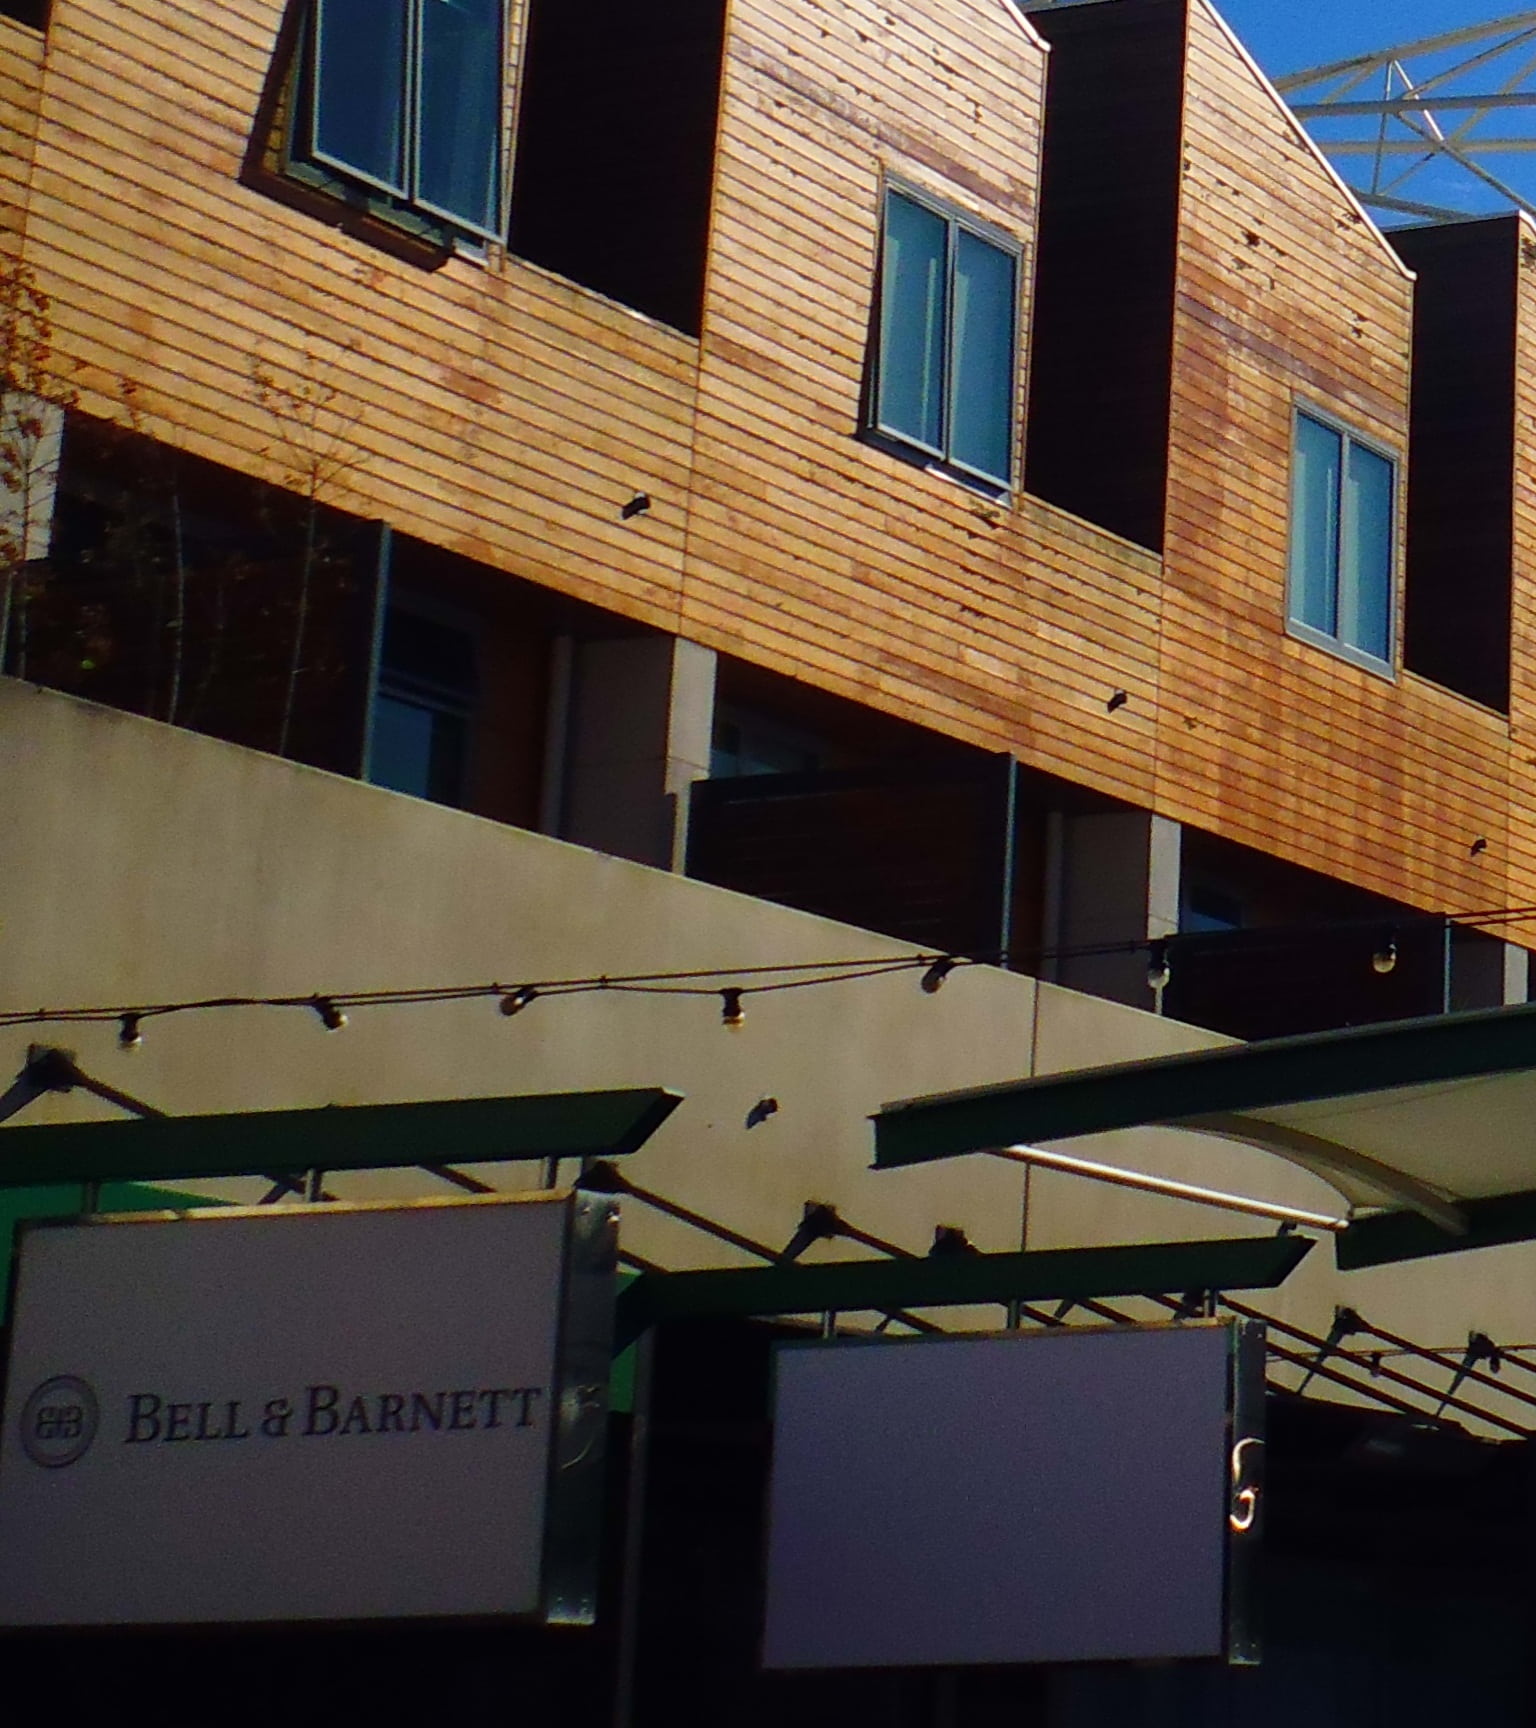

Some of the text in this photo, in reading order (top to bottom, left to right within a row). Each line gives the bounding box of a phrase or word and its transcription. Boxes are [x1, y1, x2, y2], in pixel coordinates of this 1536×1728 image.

[123, 1384, 543, 1444] BELL & BARNETT
